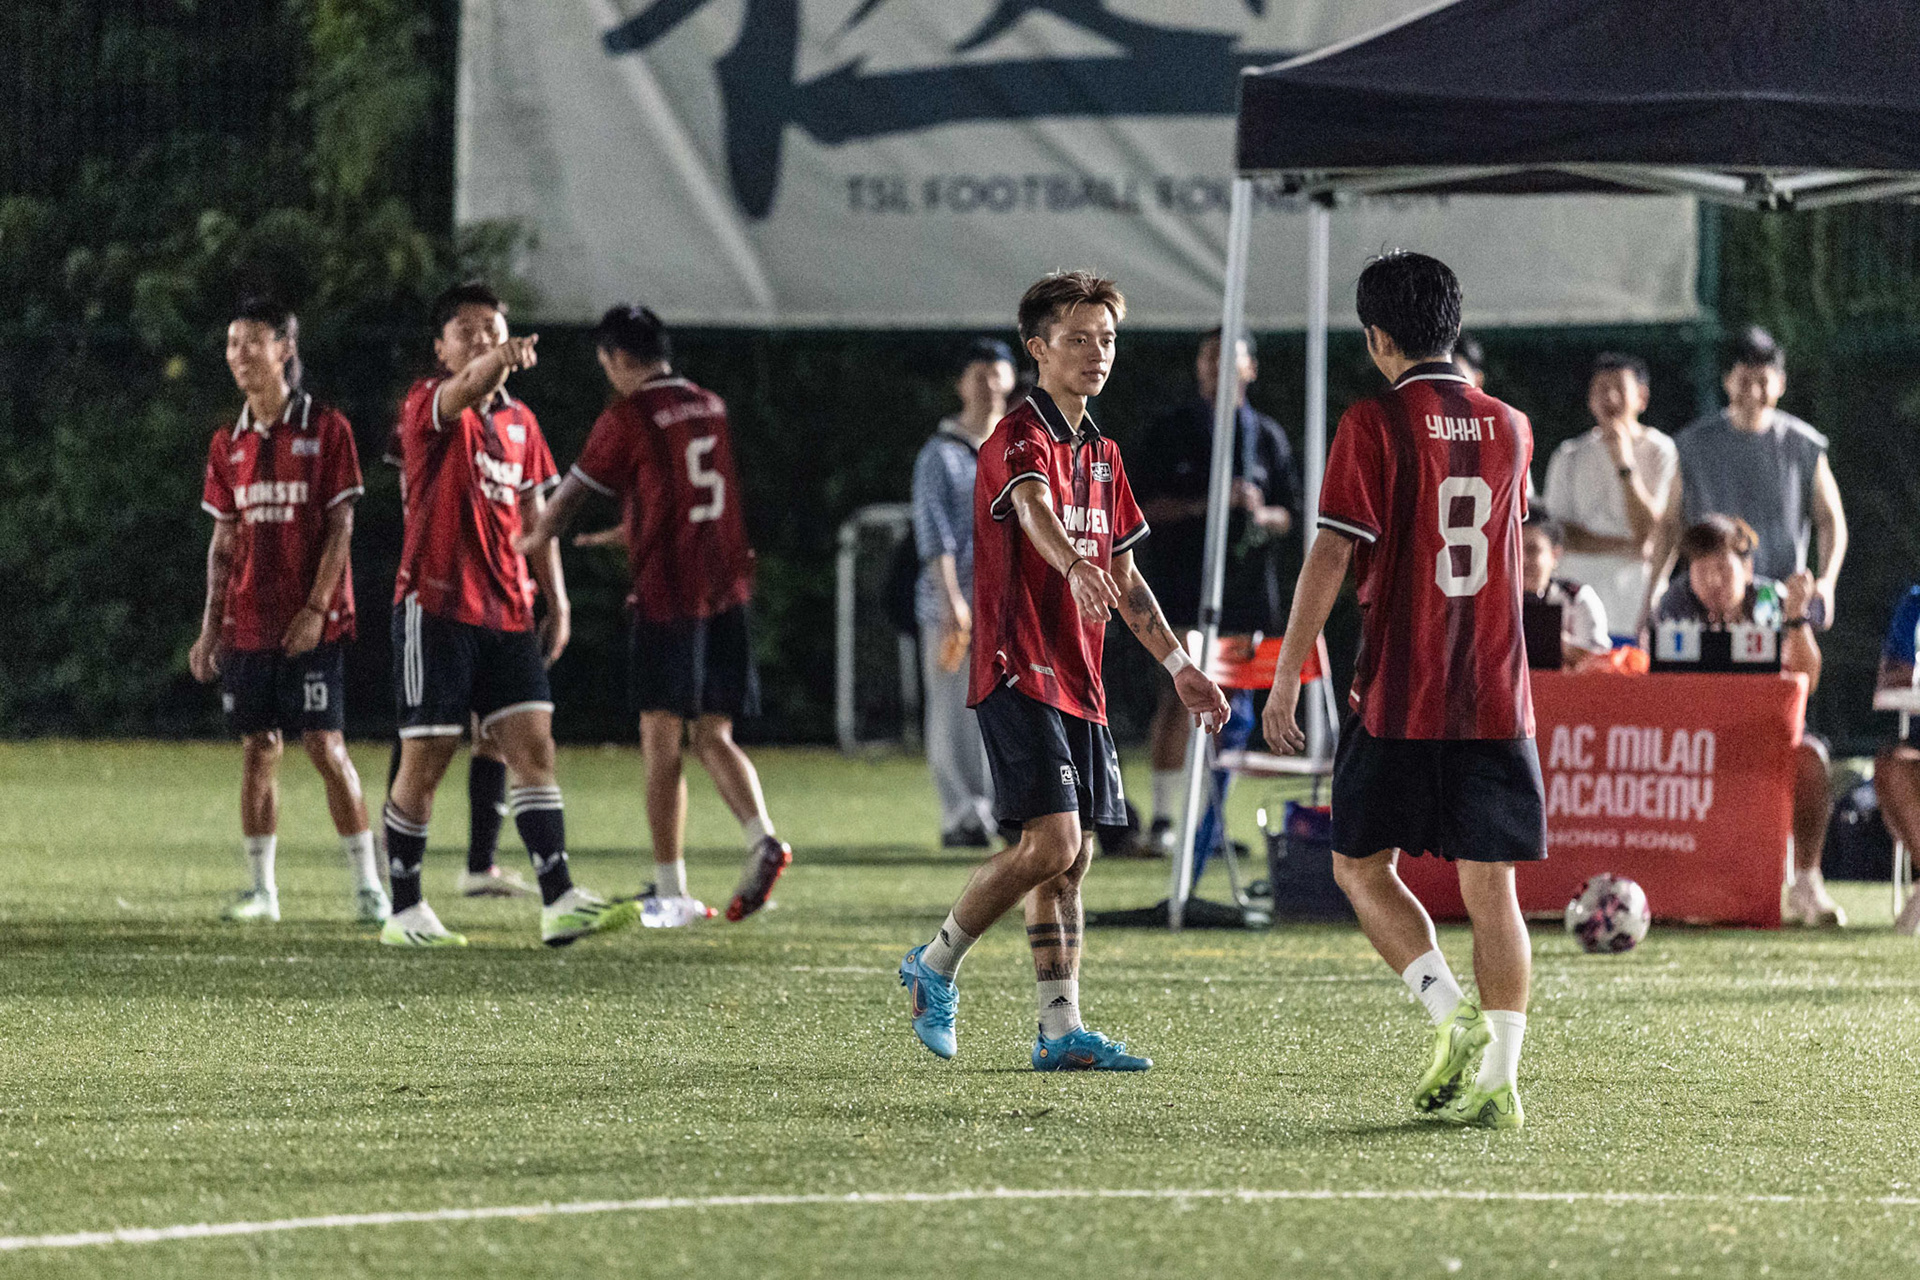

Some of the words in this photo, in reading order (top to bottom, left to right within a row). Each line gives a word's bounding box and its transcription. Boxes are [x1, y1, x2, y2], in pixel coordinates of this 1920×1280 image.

[685, 435, 725, 522] 5
[1435, 476, 1492, 597] 8
[303, 682, 329, 712] 19
[1549, 724, 1596, 769] AC
[1606, 725, 1715, 773] MILAN
[1548, 773, 1714, 821] ACADEMY
[1624, 831, 1697, 852] KONG
